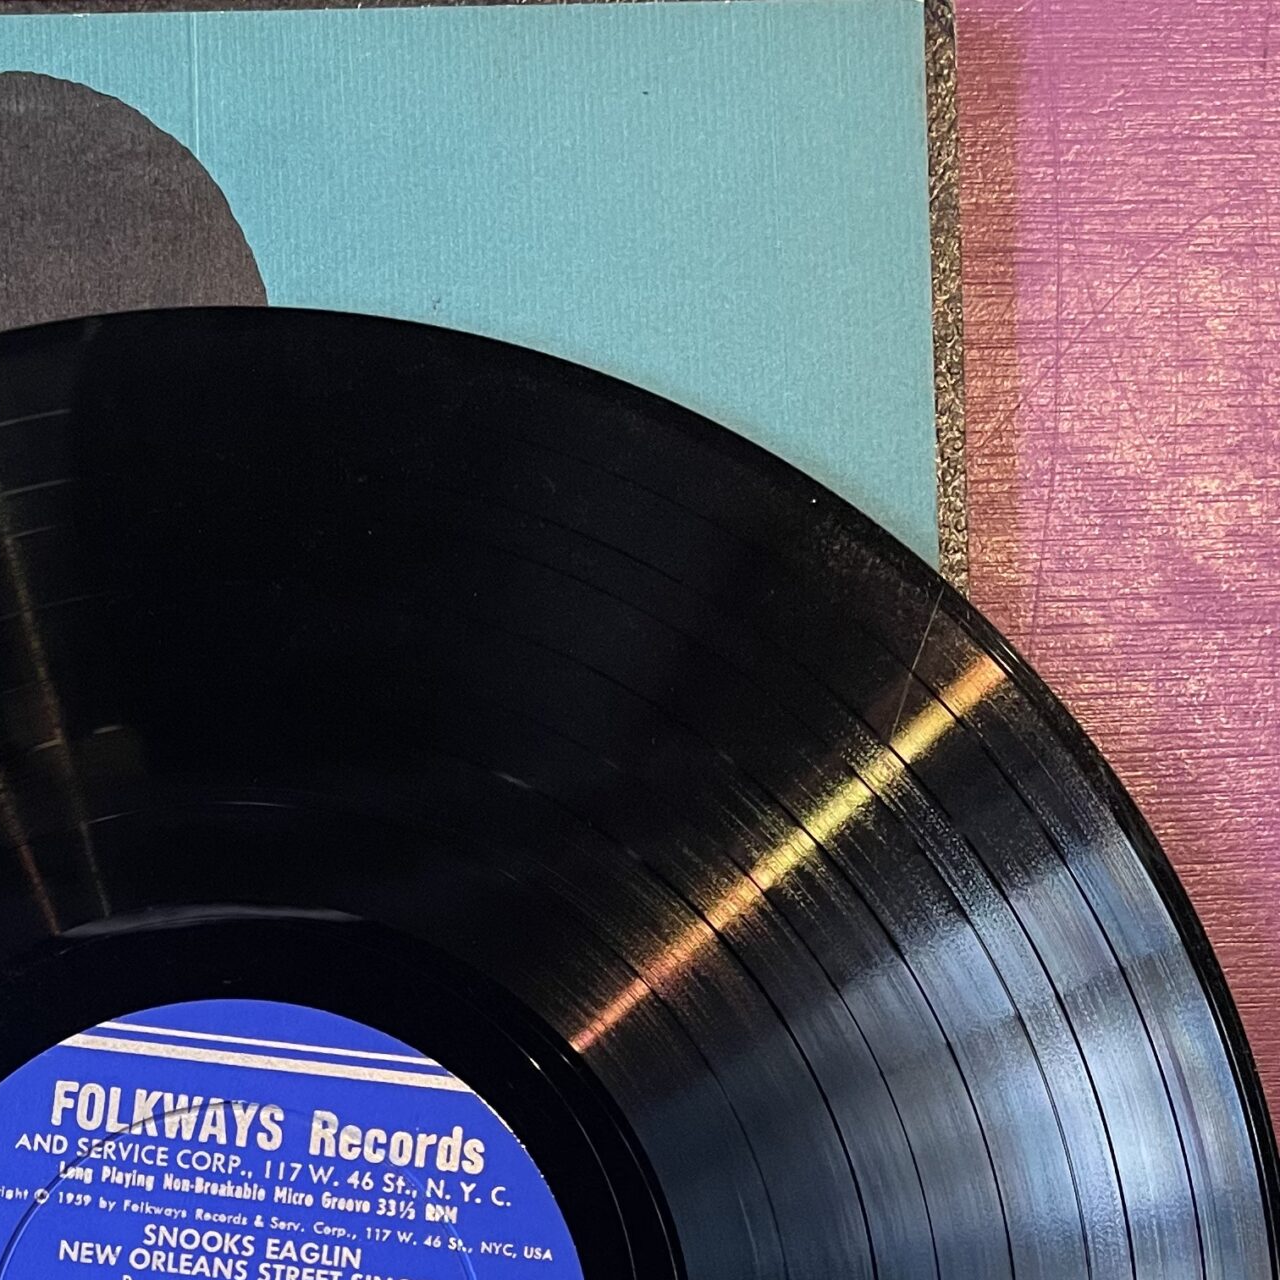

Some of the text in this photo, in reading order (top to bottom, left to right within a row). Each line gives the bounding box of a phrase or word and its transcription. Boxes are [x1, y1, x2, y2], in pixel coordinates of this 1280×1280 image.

[51, 1081, 485, 1175] FOLKWAYS Records
[15, 1134, 511, 1207] AND SERVICE CORP., 117 W. 46 St., N. Y. C.
[60, 1161, 93, 1184] Long
[102, 1166, 155, 1192] Playing
[163, 1173, 266, 1201] Non-Breakable
[274, 1186, 314, 1207] Micro
[322, 1192, 371, 1213] Groove
[59, 1192, 92, 1206] 1959
[99, 1197, 116, 1212] by
[124, 1200, 187, 1219] Folkways
[195, 1209, 248, 1225] Records
[254, 1215, 264, 1228] &
[270, 1217, 305, 1232] Serv.
[314, 1222, 356, 1240] Corp.,
[367, 1228, 392, 1241] 117
[397, 1231, 417, 1245] W.
[424, 1236, 442, 1248] 46
[448, 1237, 473, 1253] St.,
[481, 1242, 517, 1258] NYC,
[524, 1246, 553, 1261] USA
[59, 1240, 122, 1266] NEW
[143, 1224, 362, 1269] SNOOKS EAGLIN
